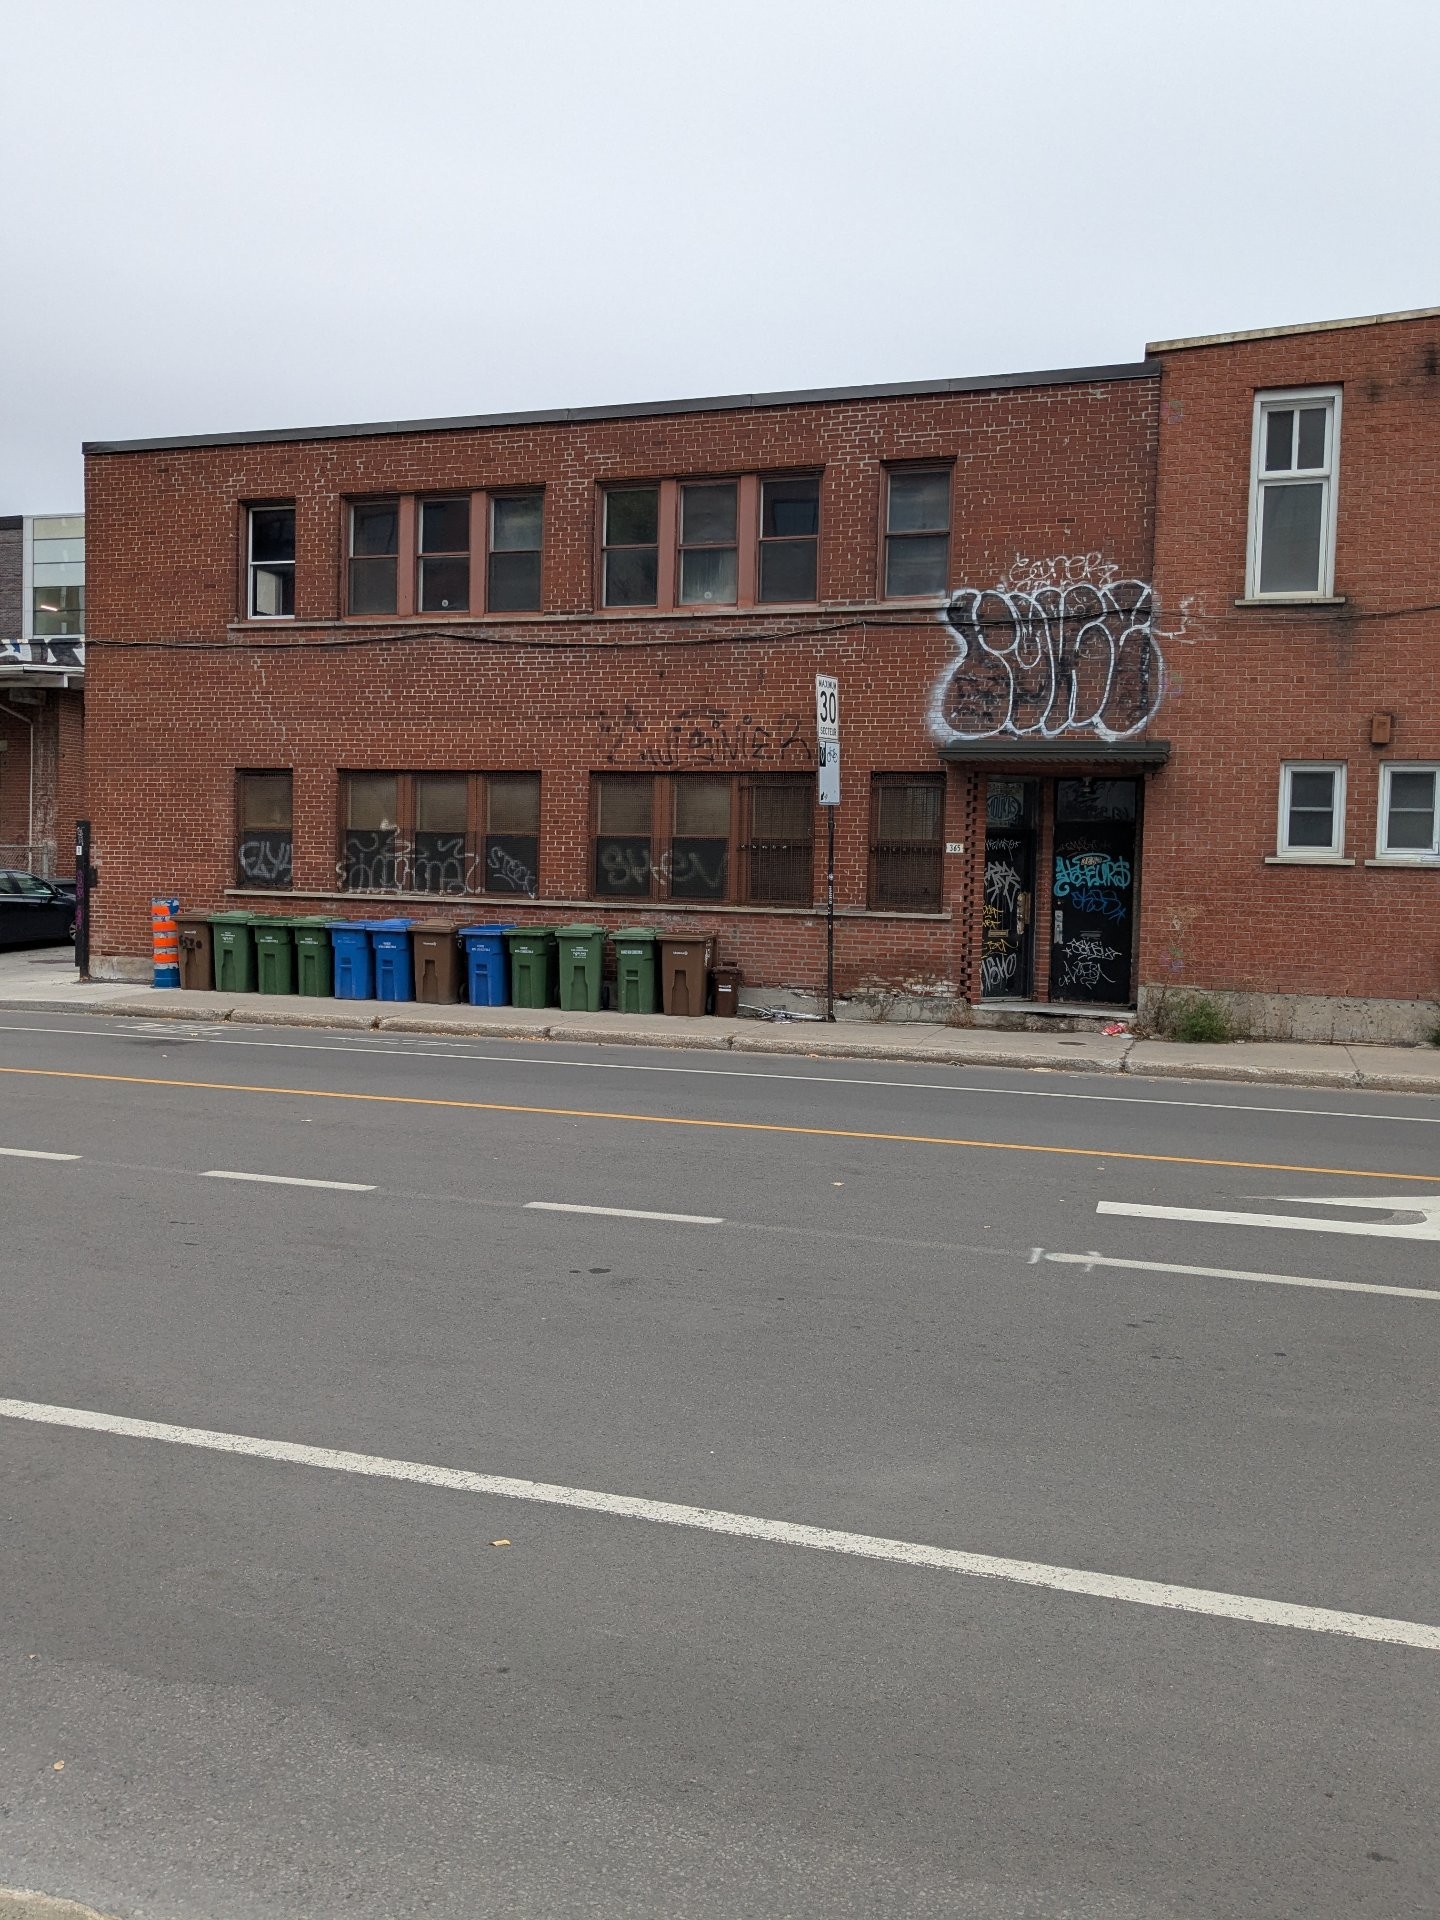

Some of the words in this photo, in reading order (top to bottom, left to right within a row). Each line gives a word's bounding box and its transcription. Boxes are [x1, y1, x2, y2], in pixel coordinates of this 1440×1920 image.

[819, 680, 837, 690] MAXIMUM
[820, 691, 836, 724] 30
[820, 727, 837, 736] SECTEUR
[949, 844, 961, 852] 365
